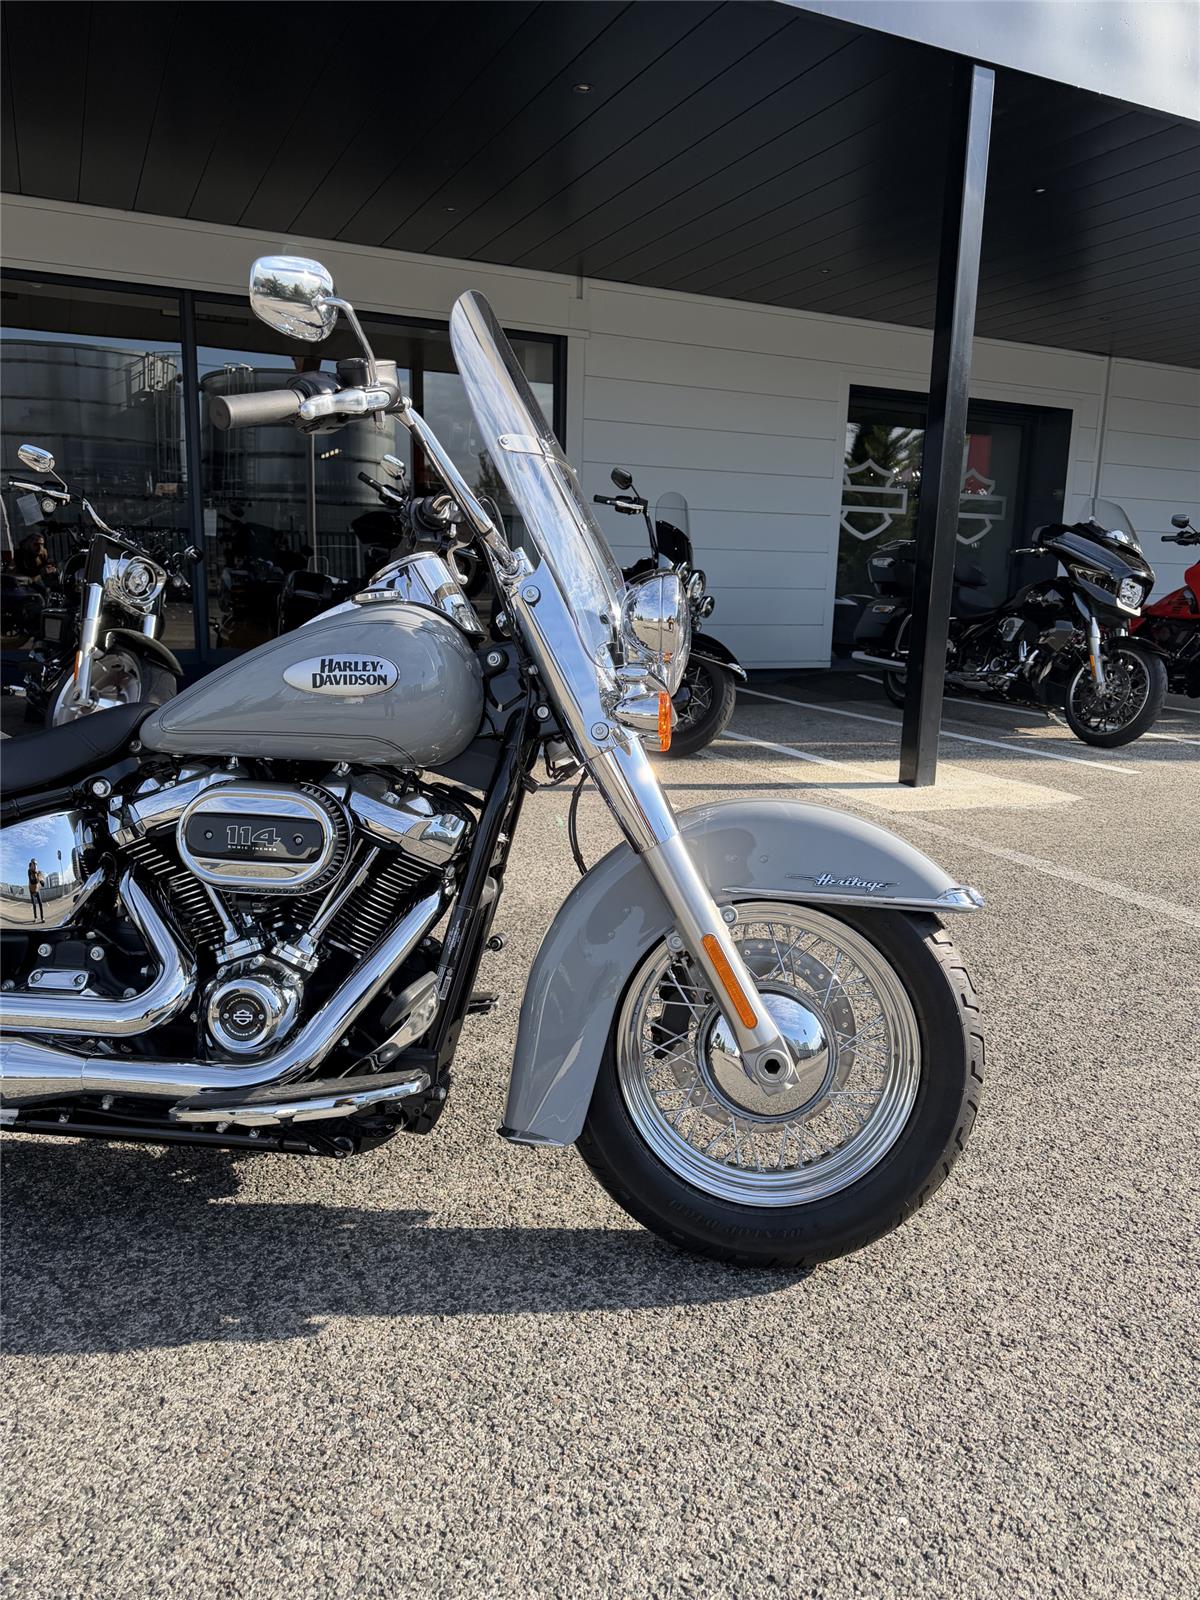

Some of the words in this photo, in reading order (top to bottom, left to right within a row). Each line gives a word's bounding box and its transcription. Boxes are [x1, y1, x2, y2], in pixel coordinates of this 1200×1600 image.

[312, 673, 388, 688] DAVIDSON
[226, 825, 281, 847] 114
[815, 873, 890, 892] Heritage
